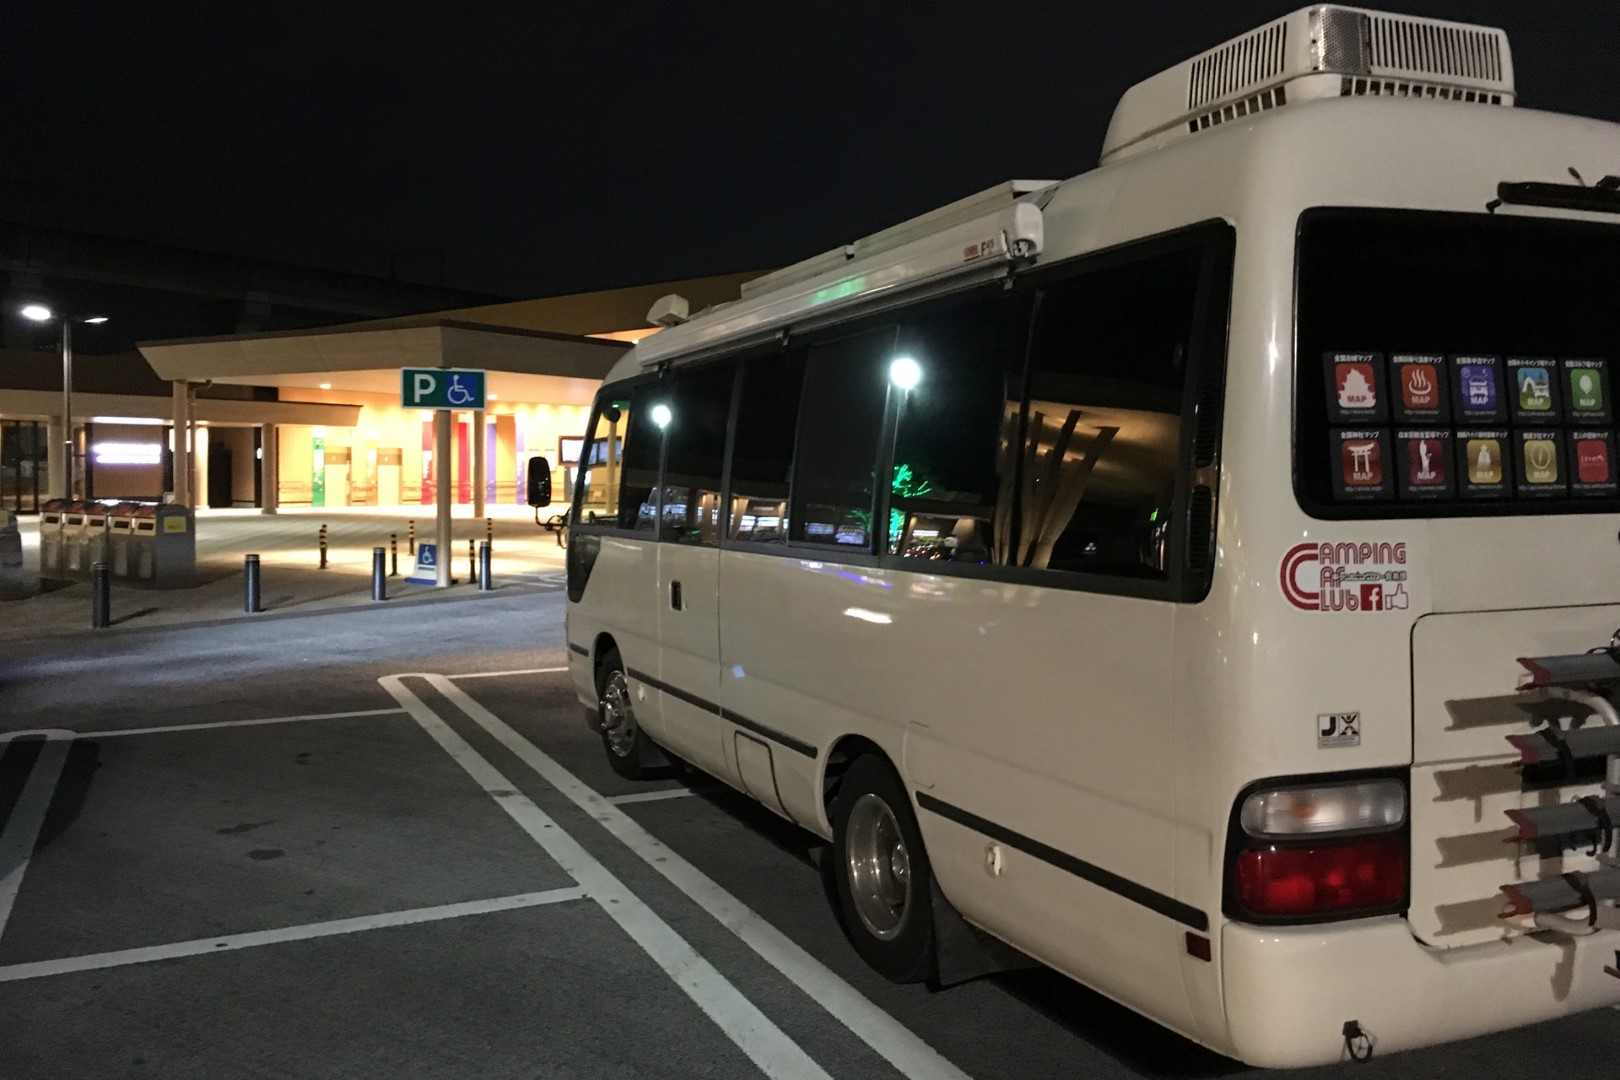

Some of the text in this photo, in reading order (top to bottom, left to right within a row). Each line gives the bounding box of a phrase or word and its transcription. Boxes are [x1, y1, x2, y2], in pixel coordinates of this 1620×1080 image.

[414, 373, 437, 403] P
[1347, 395, 1367, 403] MAP
[1412, 396, 1431, 404] MAP
[1470, 396, 1489, 405] MAP
[1352, 472, 1374, 480] MAP
[1417, 471, 1437, 480] MAP
